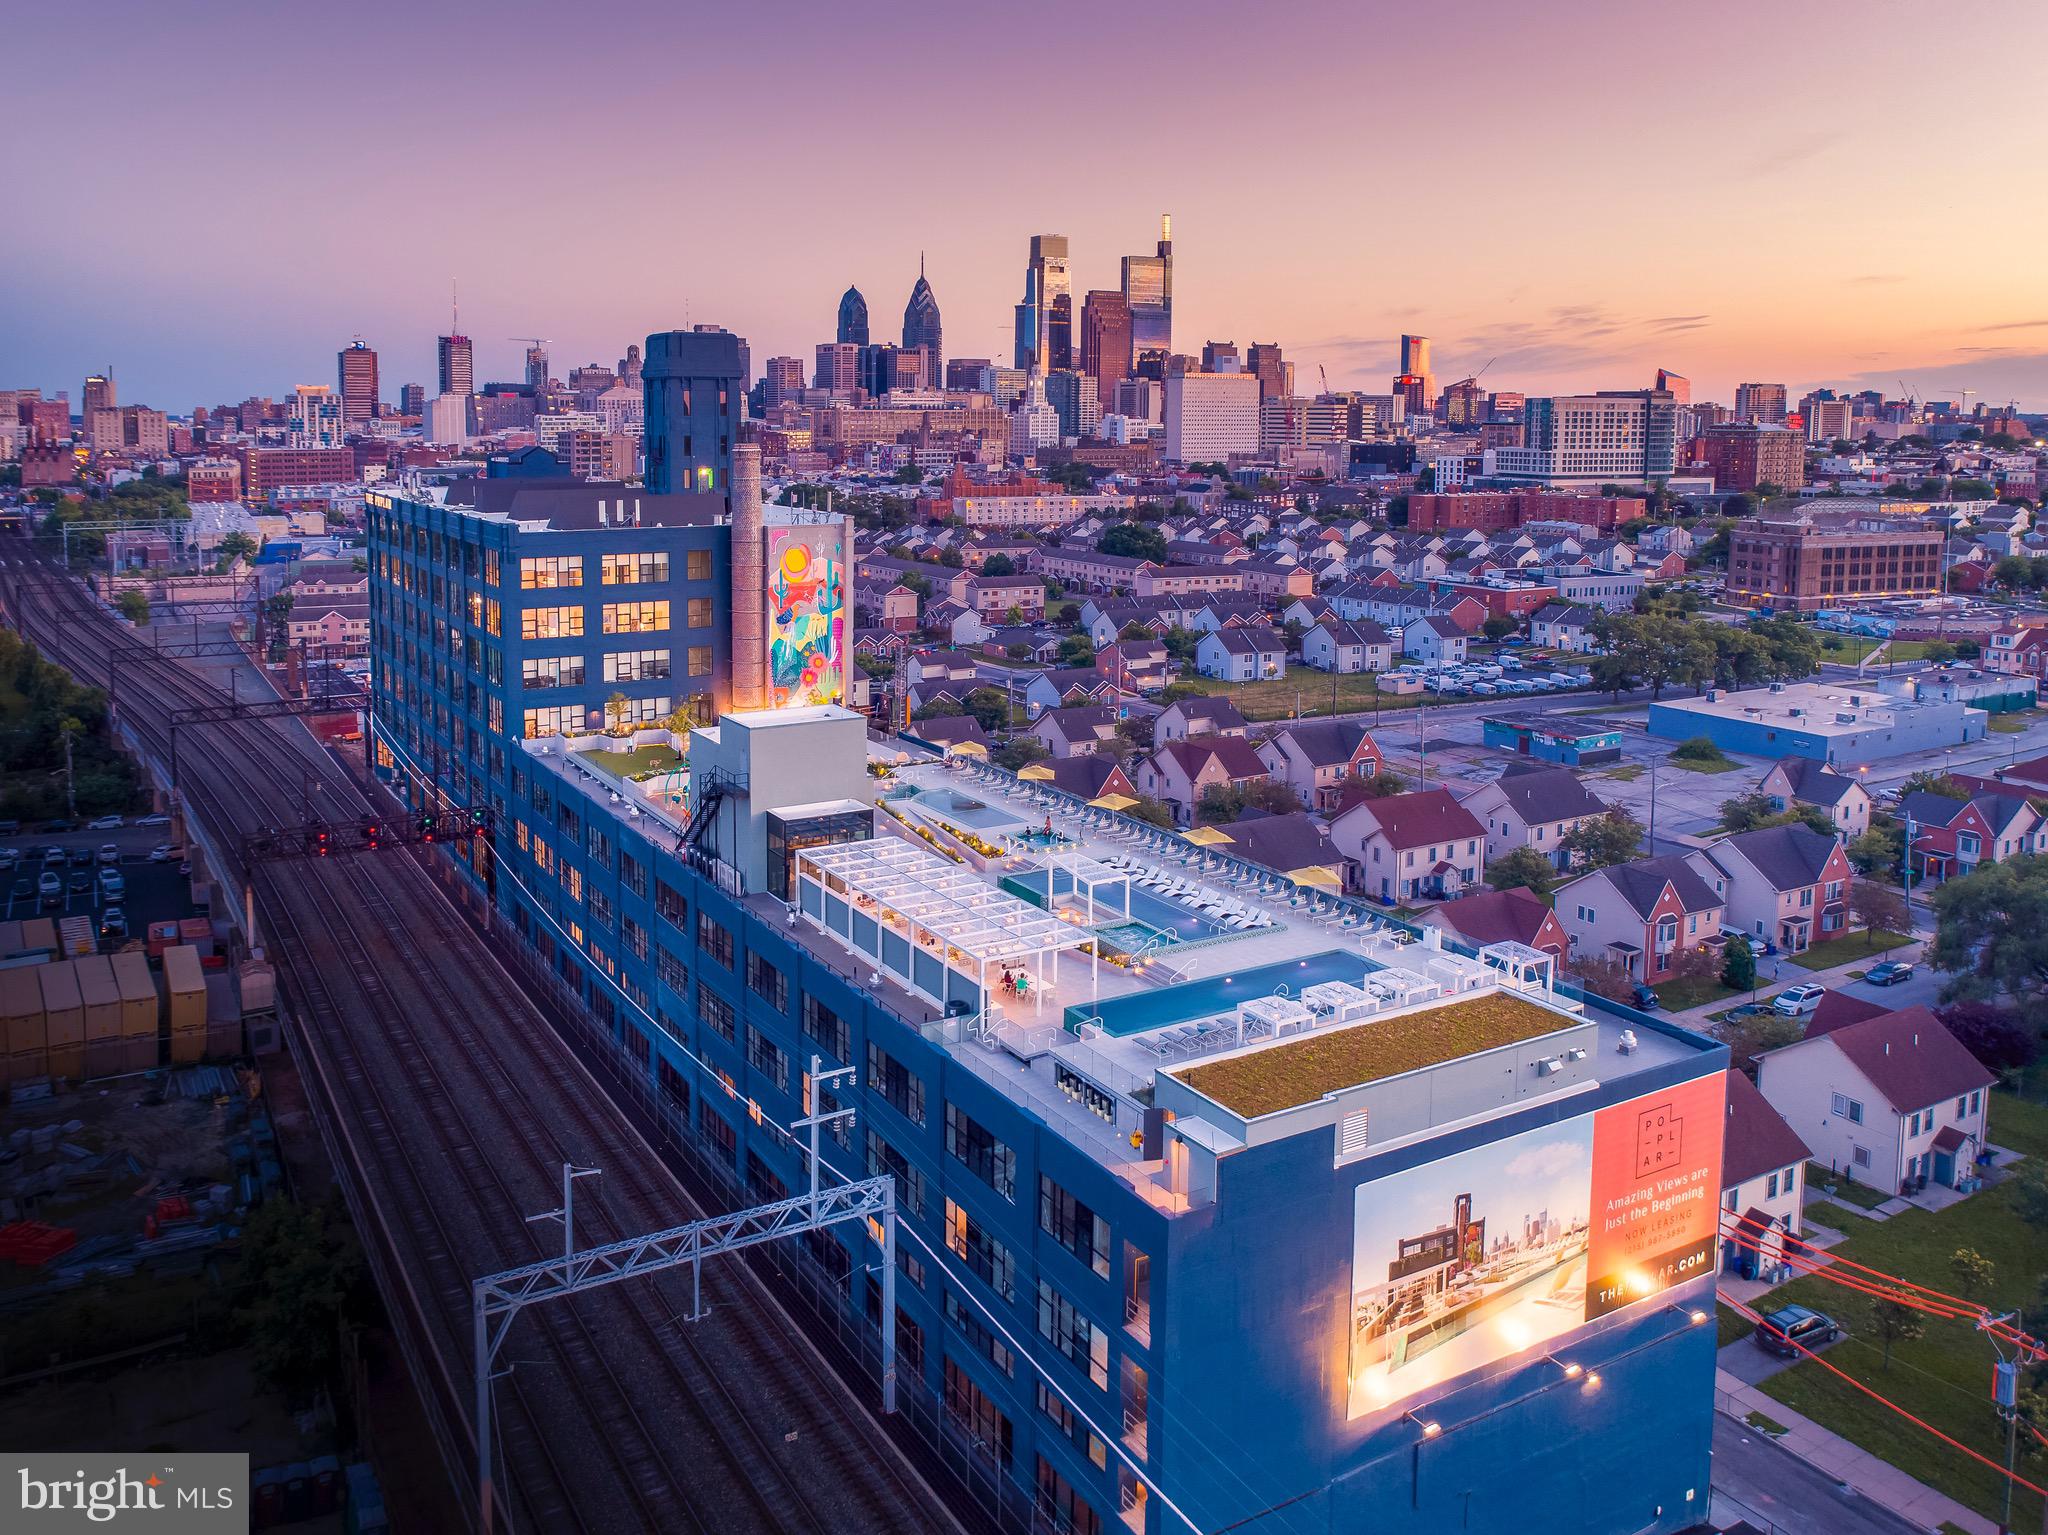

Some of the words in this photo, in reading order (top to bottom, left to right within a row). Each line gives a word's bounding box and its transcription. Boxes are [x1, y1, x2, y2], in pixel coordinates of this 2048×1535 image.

[1604, 1213, 1627, 1232] Just
[1630, 1207, 1648, 1220] the
[1651, 1186, 1704, 1213] Beginning
[1606, 1186, 1653, 1212] Amazing
[1656, 1174, 1688, 1193] Views
[1691, 1167, 1709, 1181] are
[1625, 1226, 1647, 1241] NOW
[1651, 1209, 1692, 1231] LEASING
[1599, 1251, 1705, 1303] THELAR.COM
